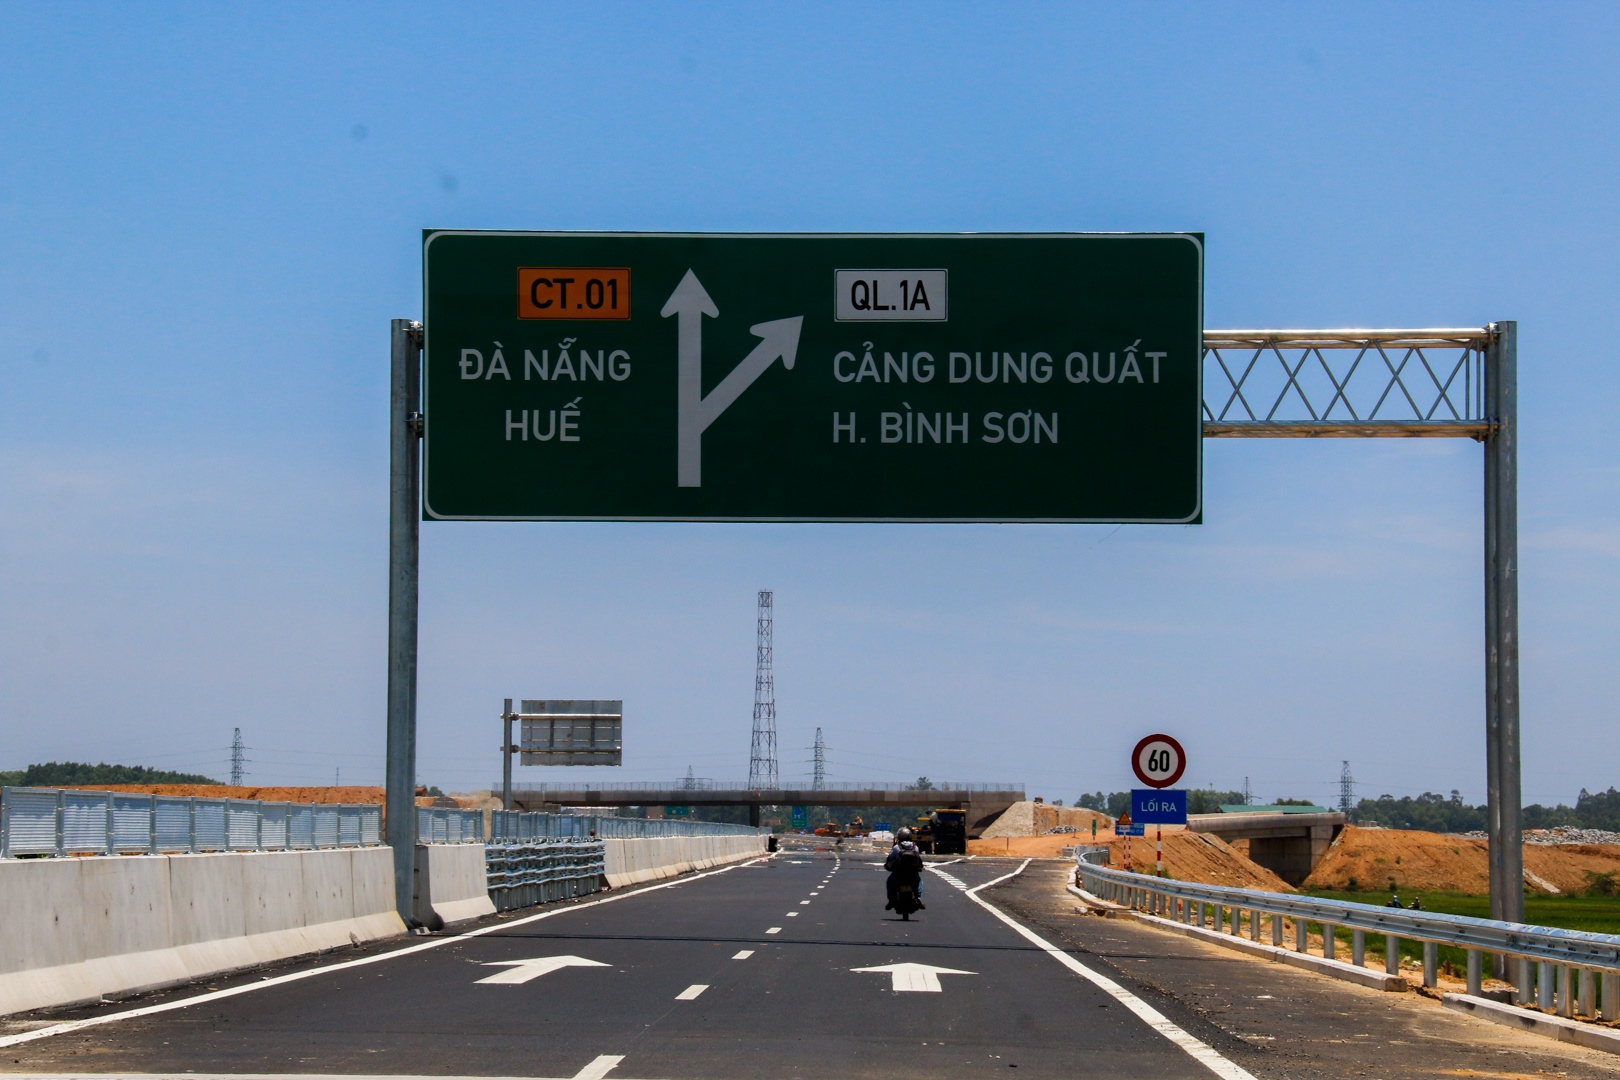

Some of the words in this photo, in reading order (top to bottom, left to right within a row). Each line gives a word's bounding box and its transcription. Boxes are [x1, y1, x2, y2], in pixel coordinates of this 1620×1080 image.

[530, 278, 618, 310] CT.01
[850, 279, 931, 312] QL.1A
[458, 340, 511, 381] ĐÀ
[524, 337, 632, 381] NẴNG
[833, 341, 936, 384] CẢNG
[948, 351, 1054, 384] DUNG
[1064, 339, 1168, 384] QUẤT
[505, 396, 583, 442] HUẾ
[833, 411, 867, 444] H.
[880, 402, 969, 444] BÌNH
[981, 409, 1059, 444] SƠN
[1148, 749, 1170, 772] 60
[1141, 798, 1159, 812] LỐI
[1161, 802, 1177, 812] RA
